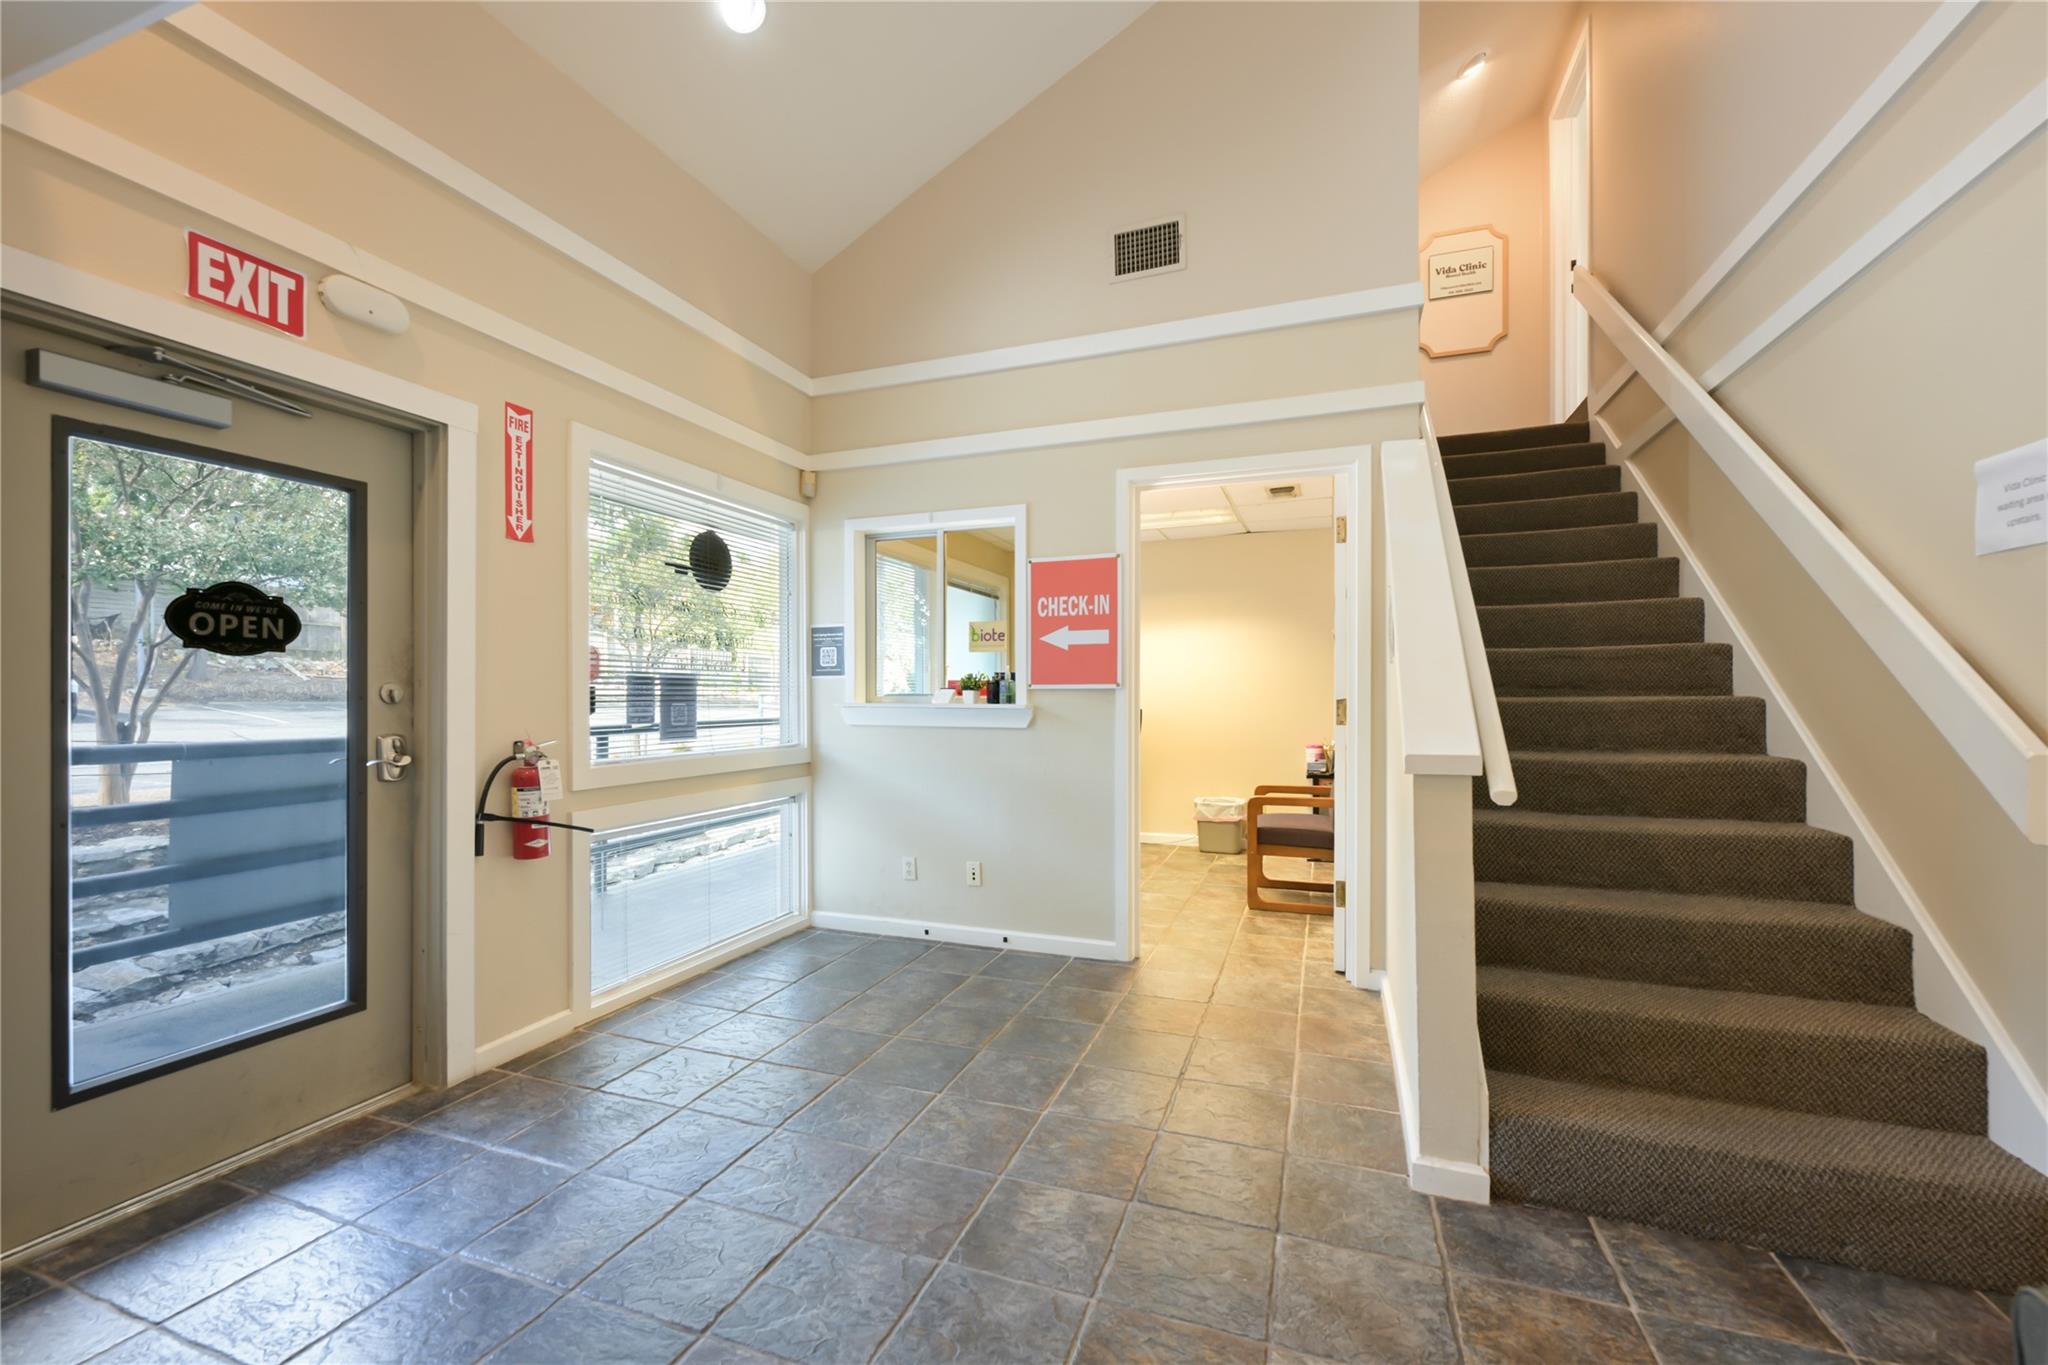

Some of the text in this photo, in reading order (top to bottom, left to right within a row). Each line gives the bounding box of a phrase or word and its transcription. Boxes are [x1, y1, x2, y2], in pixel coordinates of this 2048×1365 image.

[1435, 261, 1487, 276] Vida Clinic
[197, 241, 296, 325] EXIT
[508, 415, 529, 433] FIRE
[514, 435, 524, 532] EXTINGUISHER
[194, 600, 226, 611] COME
[230, 603, 242, 612] IN
[1037, 594, 1110, 617] CHECK-IN
[189, 611, 284, 640] OPEN
[970, 625, 1005, 642] biote
